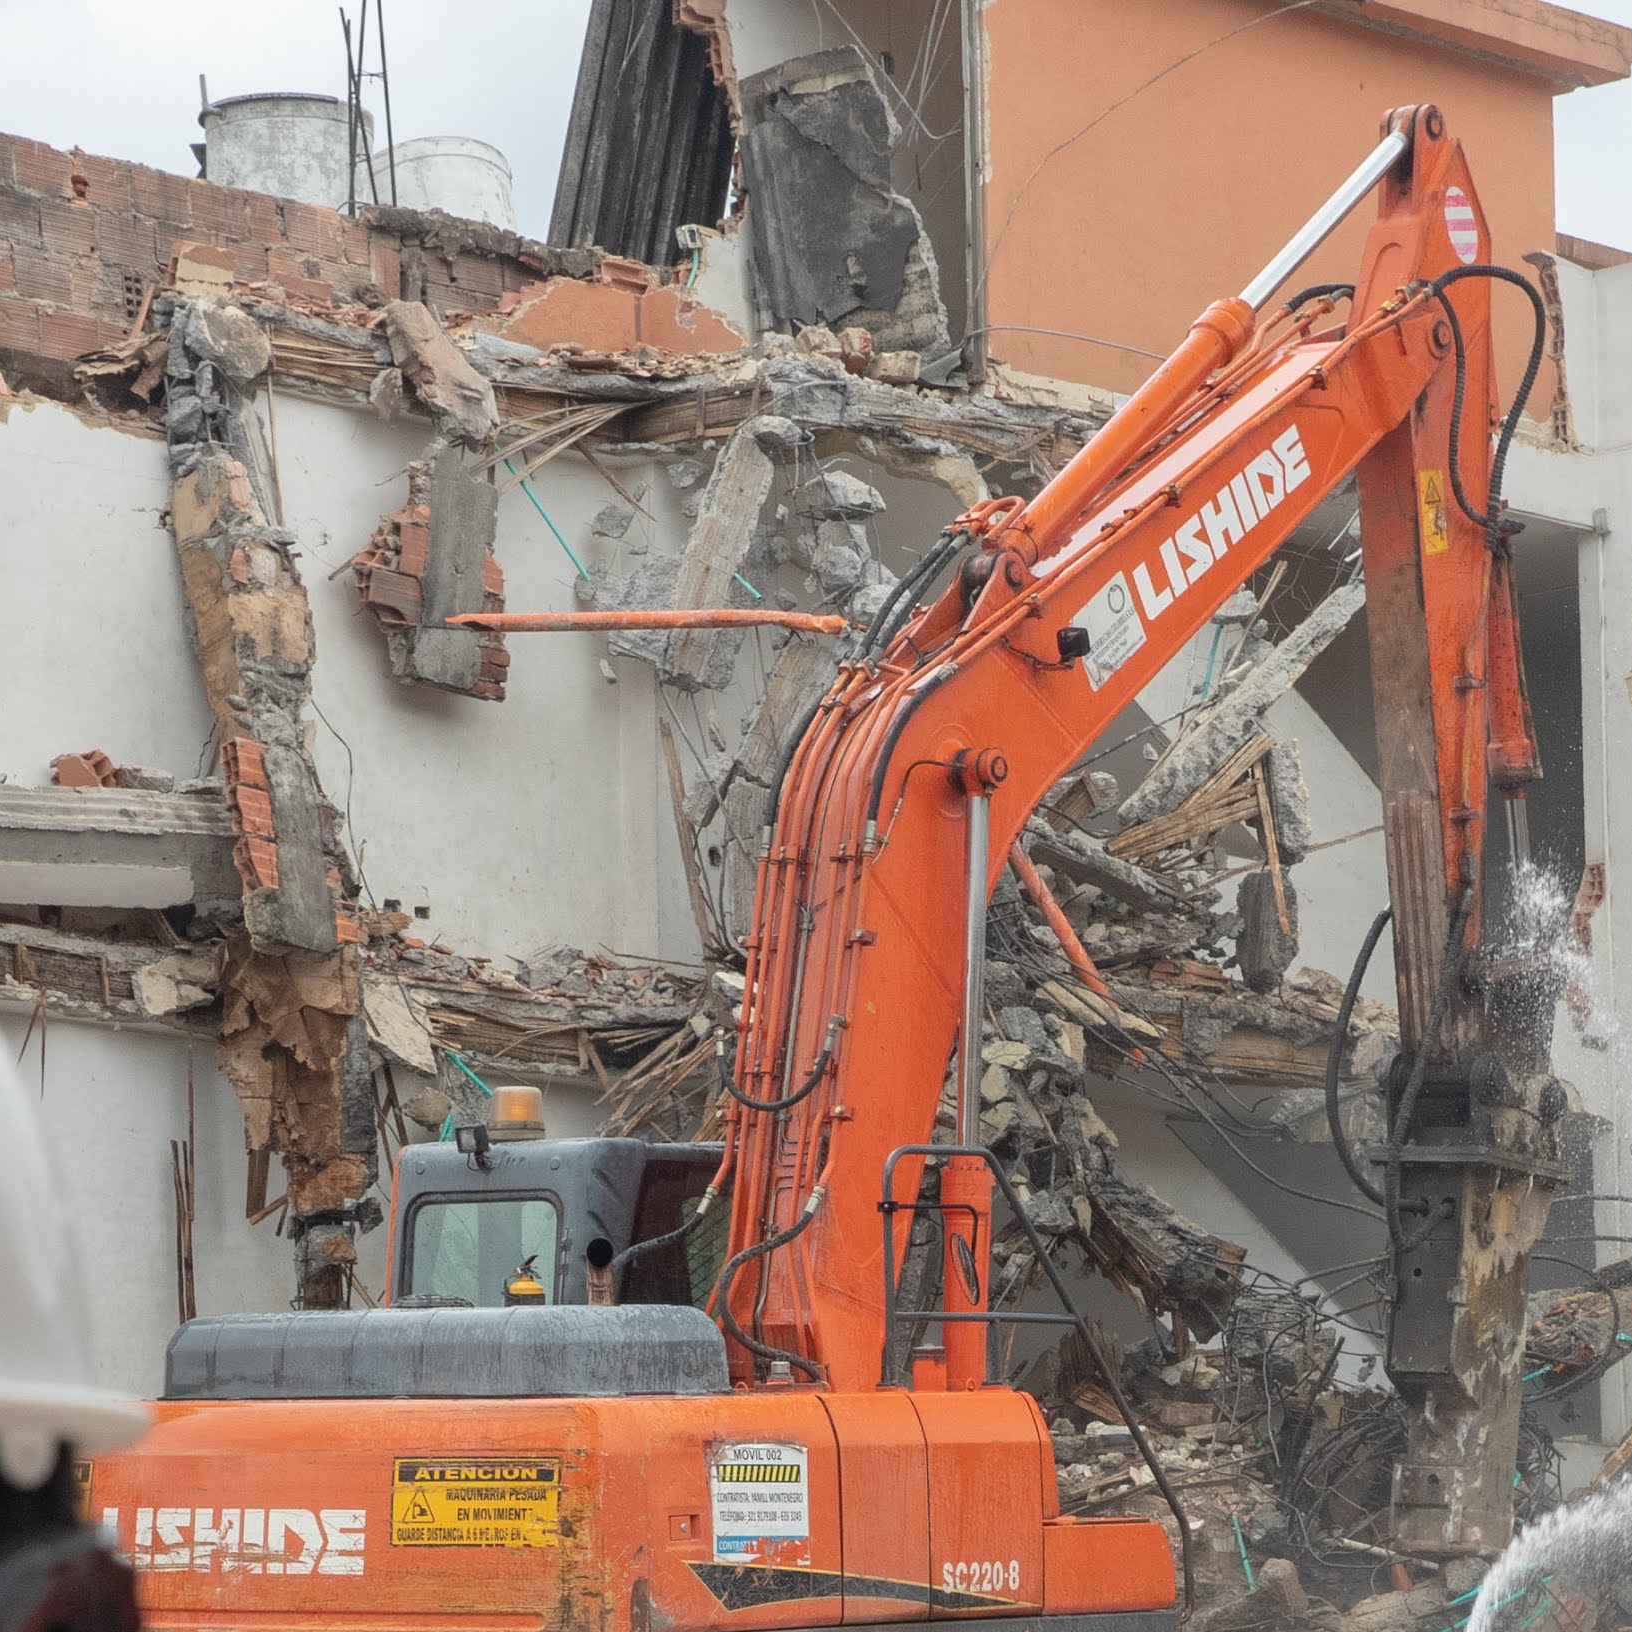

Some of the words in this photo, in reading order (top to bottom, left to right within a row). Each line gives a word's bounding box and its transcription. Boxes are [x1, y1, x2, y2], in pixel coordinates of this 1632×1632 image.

[1132, 424, 1311, 621] LISHIDE
[733, 1449, 764, 1461] MOVIL
[766, 1449, 783, 1461] 002
[446, 1488, 506, 1501] MAQUINARIA
[509, 1488, 547, 1501] PESADA
[457, 1507, 470, 1520] EN
[473, 1507, 534, 1520] MOVIMIENT
[397, 1527, 425, 1541] GUARDE
[427, 1527, 464, 1541] DISTANCIA
[466, 1527, 472, 1541] A
